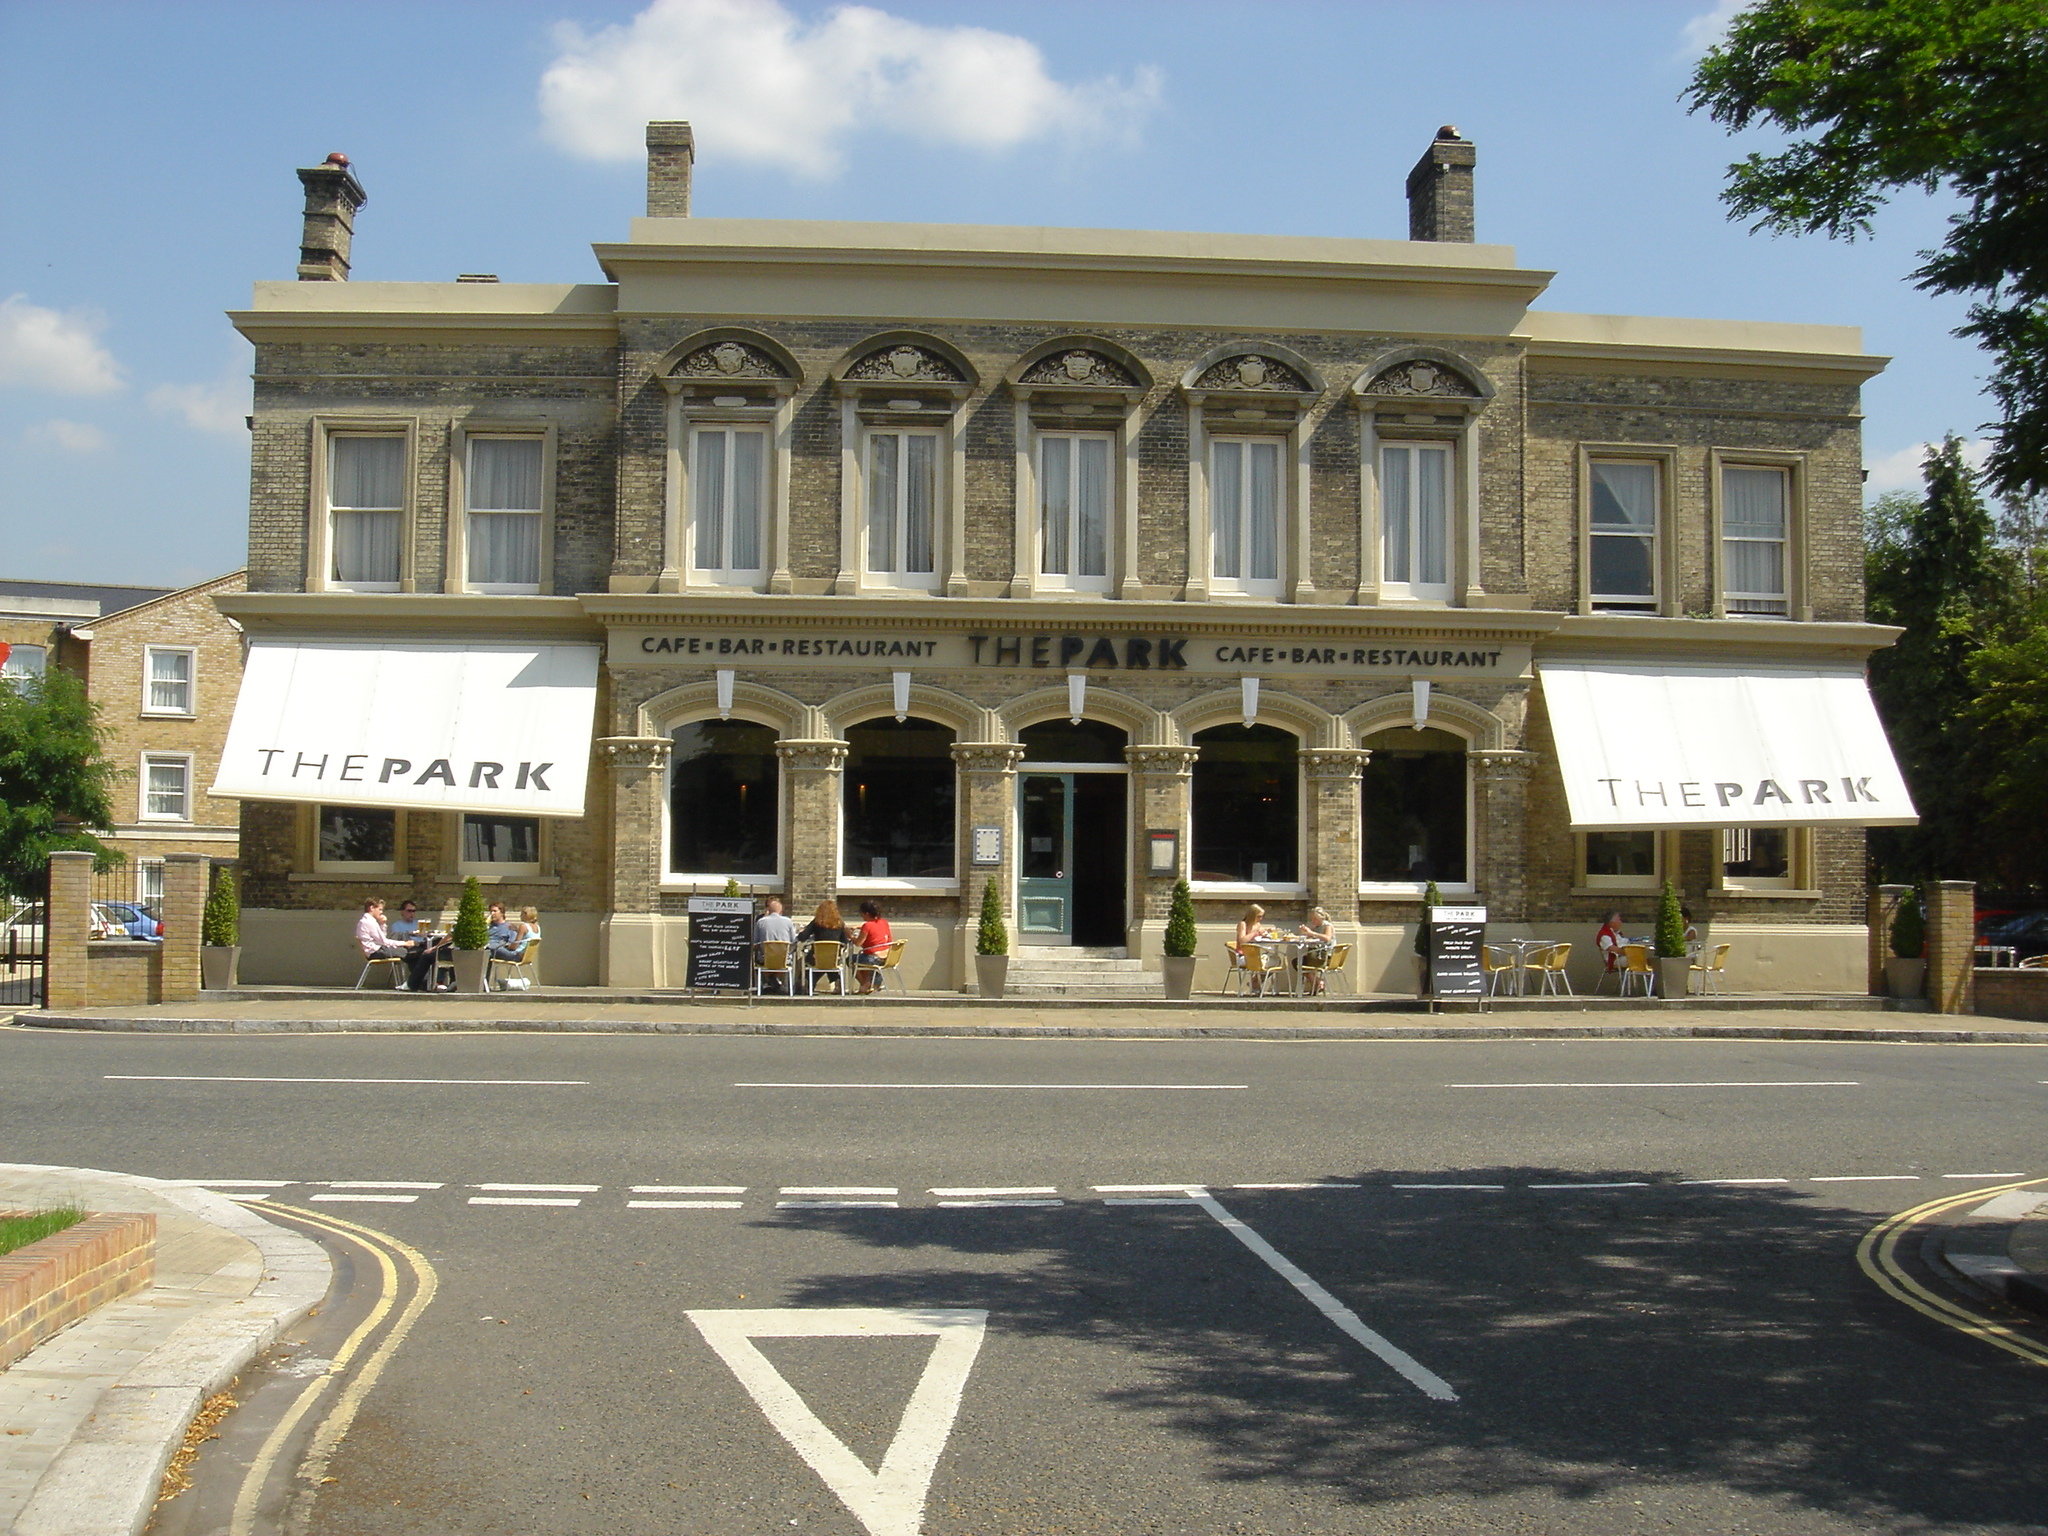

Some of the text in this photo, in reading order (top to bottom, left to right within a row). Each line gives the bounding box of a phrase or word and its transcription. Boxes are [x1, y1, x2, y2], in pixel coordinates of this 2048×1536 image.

[641, 636, 938, 658] CAFE BAR RESTAURANT
[1215, 646, 1503, 668] CAFE BAR RESTAURANT
[715, 901, 739, 909] PARK
